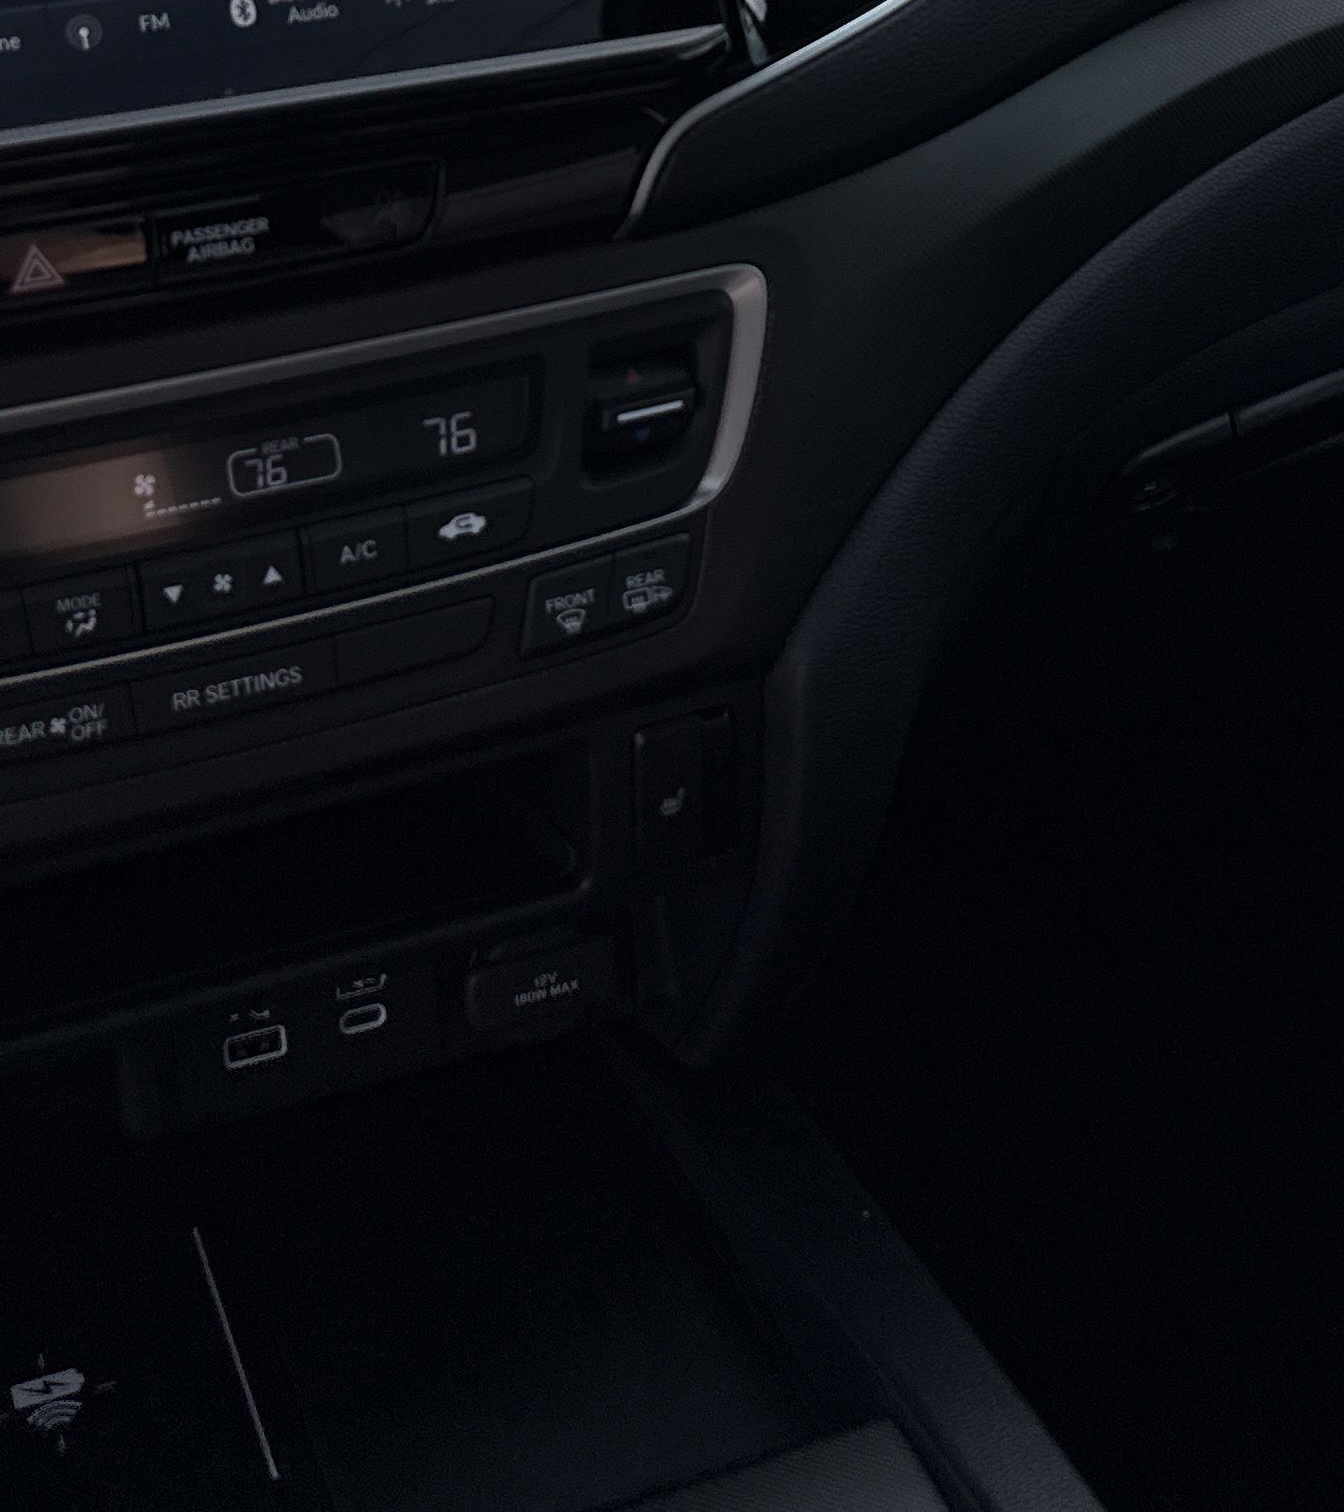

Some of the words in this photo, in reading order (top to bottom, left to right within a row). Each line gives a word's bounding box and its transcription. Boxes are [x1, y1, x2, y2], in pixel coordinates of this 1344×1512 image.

[138, 11, 171, 34] FM
[287, 2, 340, 25] Audio
[170, 216, 270, 248] PASSENGER
[186, 236, 256, 264] AIRBAG
[423, 410, 478, 457] 76
[244, 453, 288, 488] 76
[338, 538, 379, 566] A/C
[625, 567, 666, 589] REAR
[56, 591, 103, 614] MODE
[544, 587, 596, 615] FRONT
[171, 687, 202, 713] RR
[204, 665, 304, 706] SETTINGS
[67, 701, 106, 725] ON/
[69, 718, 108, 742] OFF
[548, 978, 580, 998] MAX
